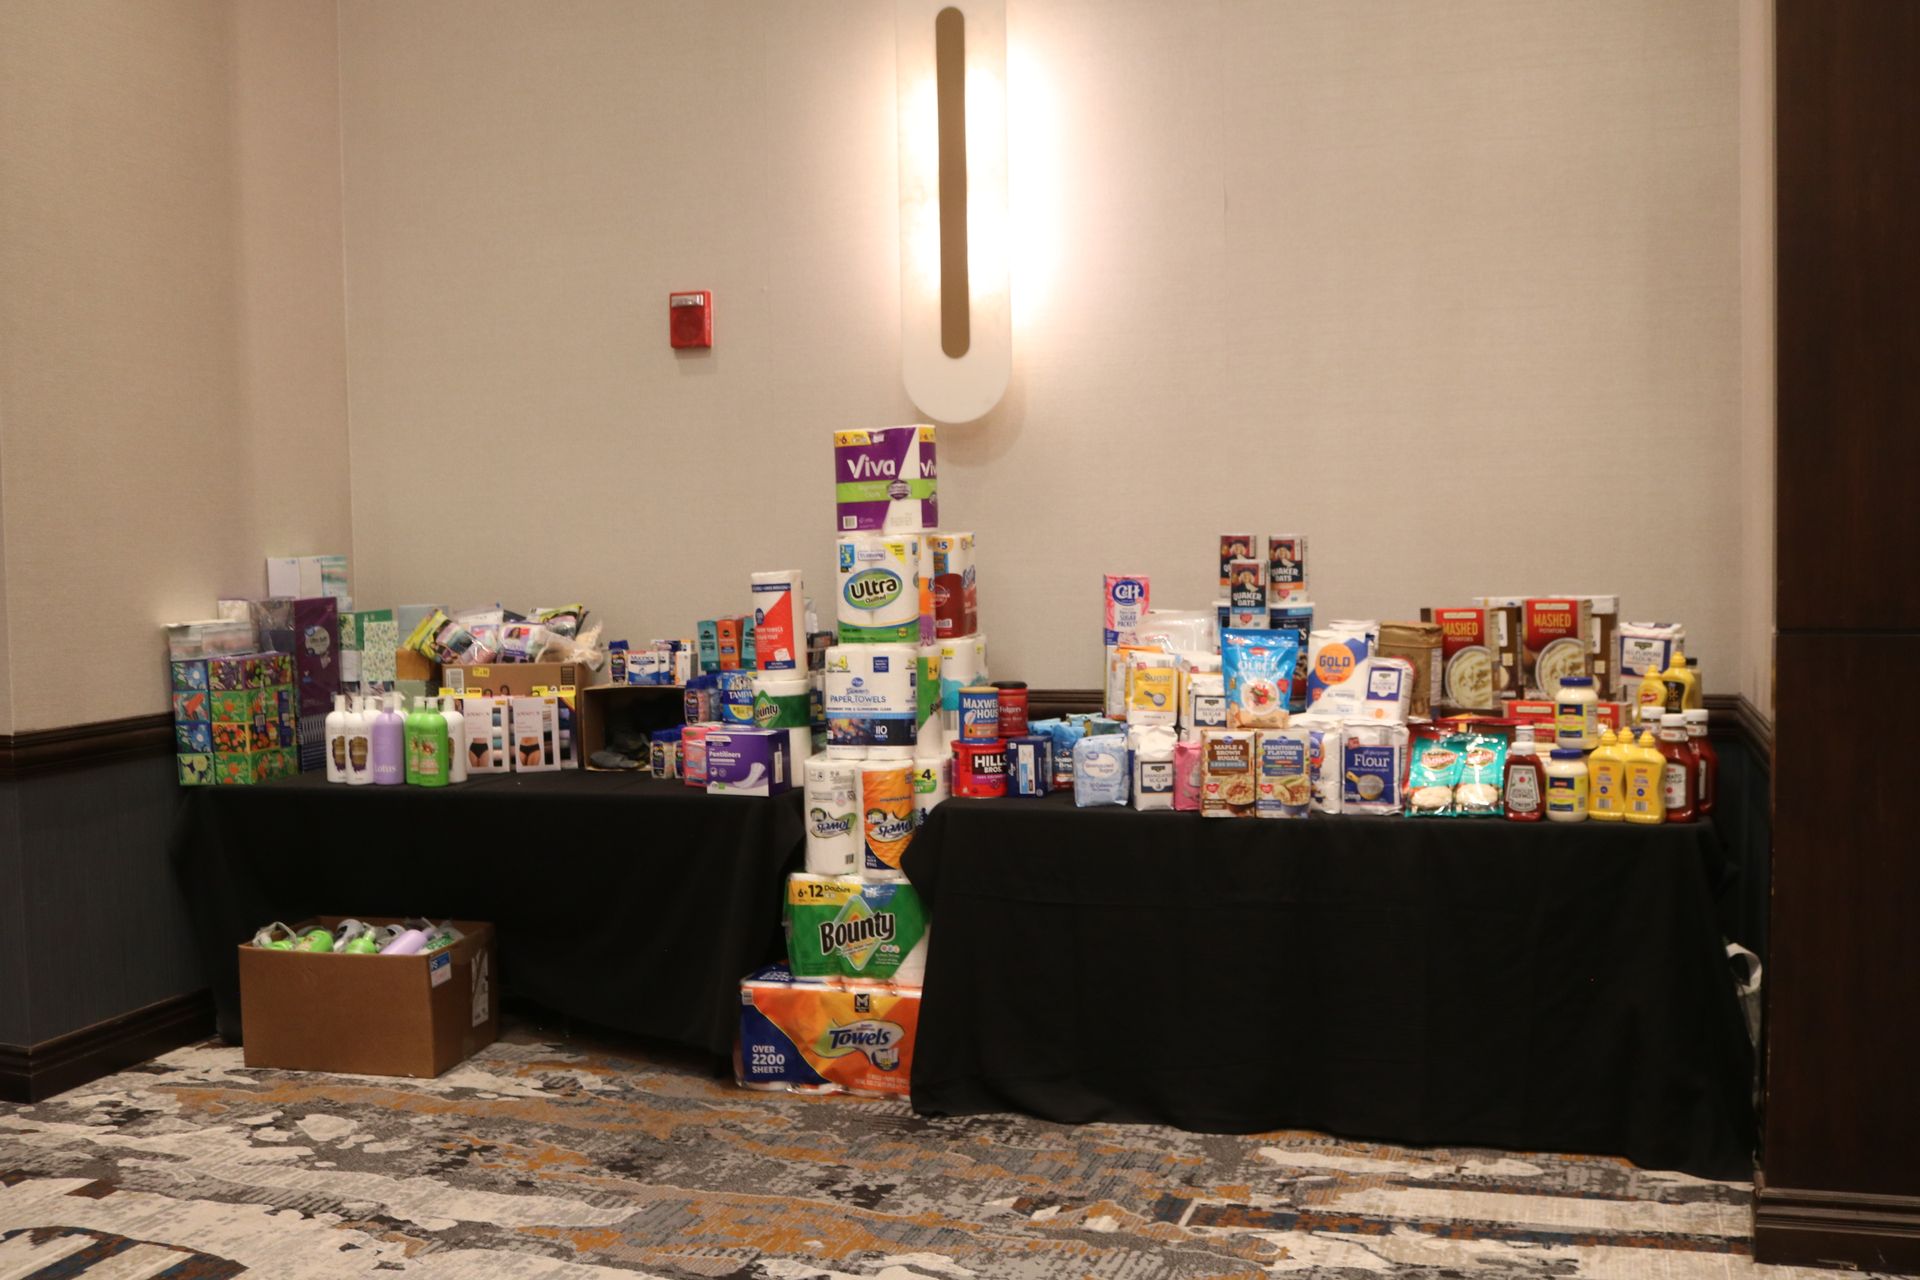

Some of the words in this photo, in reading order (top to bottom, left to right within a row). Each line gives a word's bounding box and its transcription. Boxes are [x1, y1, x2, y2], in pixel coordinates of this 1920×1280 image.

[847, 454, 896, 479] Viva
[1272, 567, 1299, 577] QUAKER
[850, 578, 897, 599] Ultra
[1115, 584, 1141, 599] C&H
[1233, 592, 1262, 601] QUAKER
[1534, 613, 1572, 627] MASHED
[1319, 656, 1351, 667] GOLD
[1144, 672, 1171, 682] Sugar
[728, 690, 753, 699] TAMPA
[855, 695, 887, 703] TOWELS
[977, 709, 998, 719] HOUS
[876, 725, 888, 735] 110
[1354, 753, 1390, 768] Flour
[922, 769, 932, 781] 4
[820, 912, 896, 954] Bounty
[829, 1028, 892, 1050] Towels
[752, 1045, 776, 1054] OVER
[752, 1054, 786, 1065] 2200
[752, 1065, 785, 1074] SHEETS
